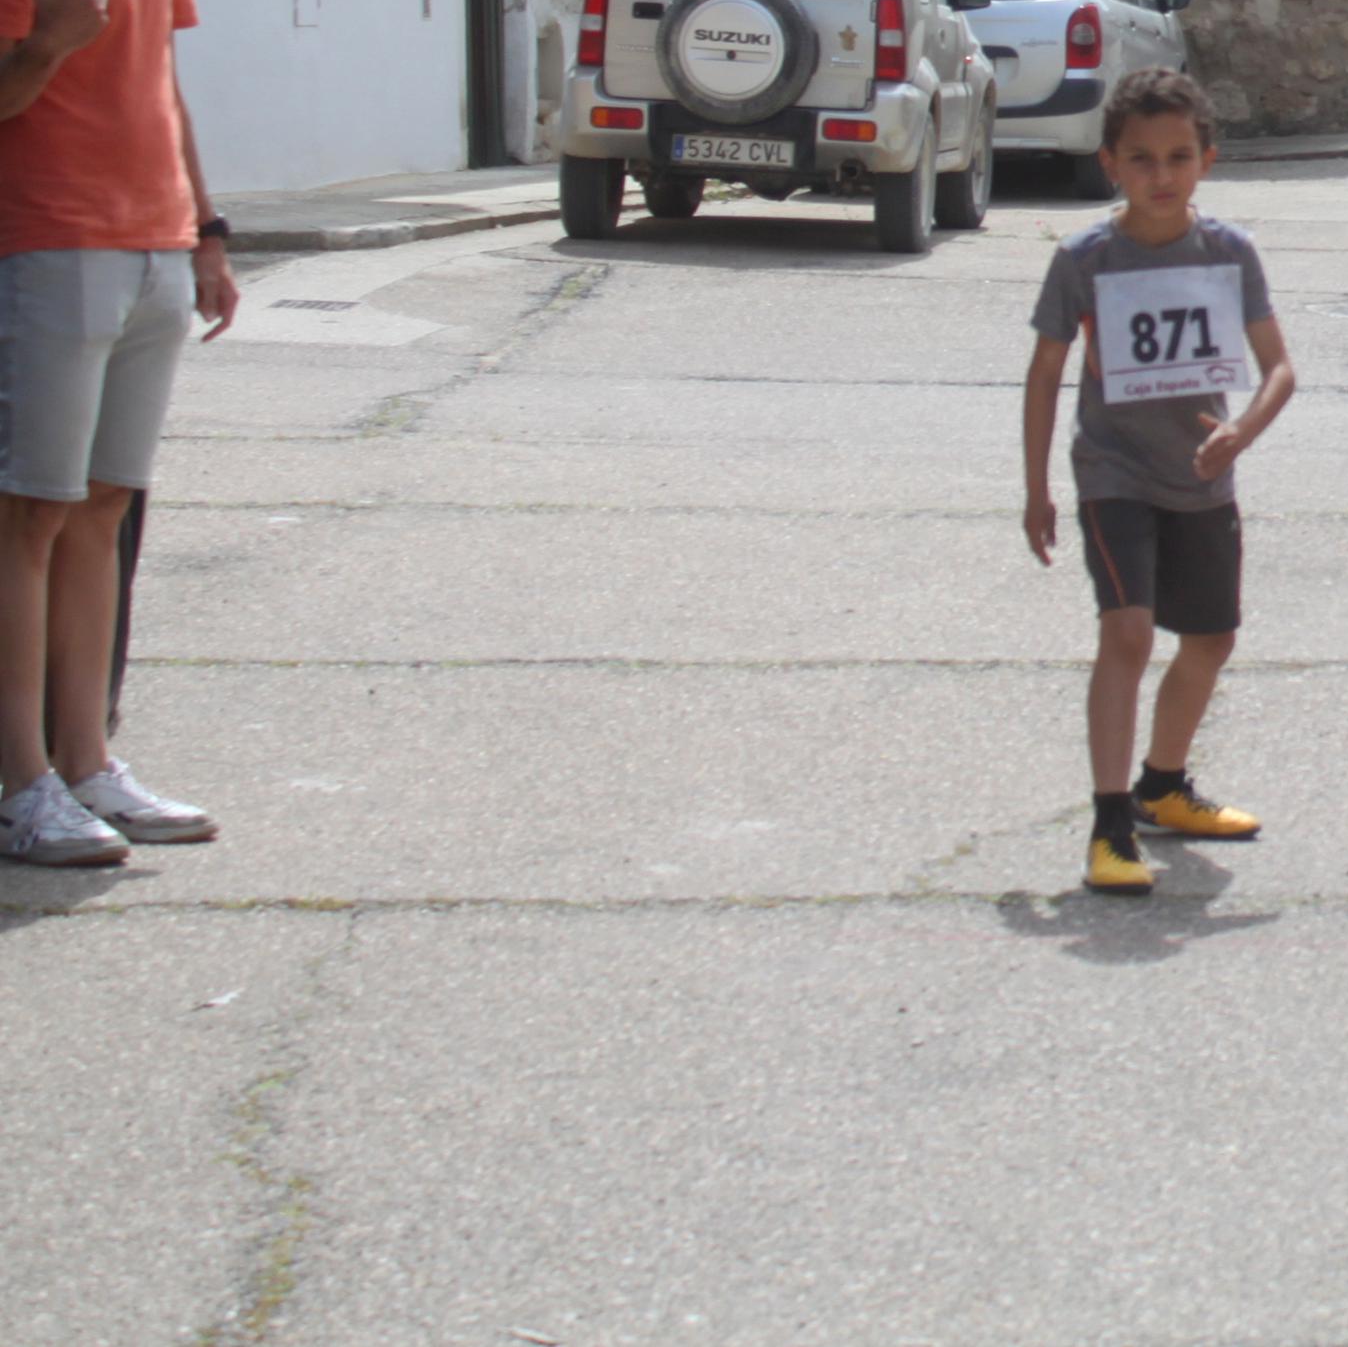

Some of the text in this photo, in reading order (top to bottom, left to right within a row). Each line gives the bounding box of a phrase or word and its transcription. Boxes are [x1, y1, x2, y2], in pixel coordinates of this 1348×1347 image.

[693, 28, 771, 46] SUZUKI
[687, 139, 788, 163] 5342 CVL
[1130, 306, 1220, 364] 871
